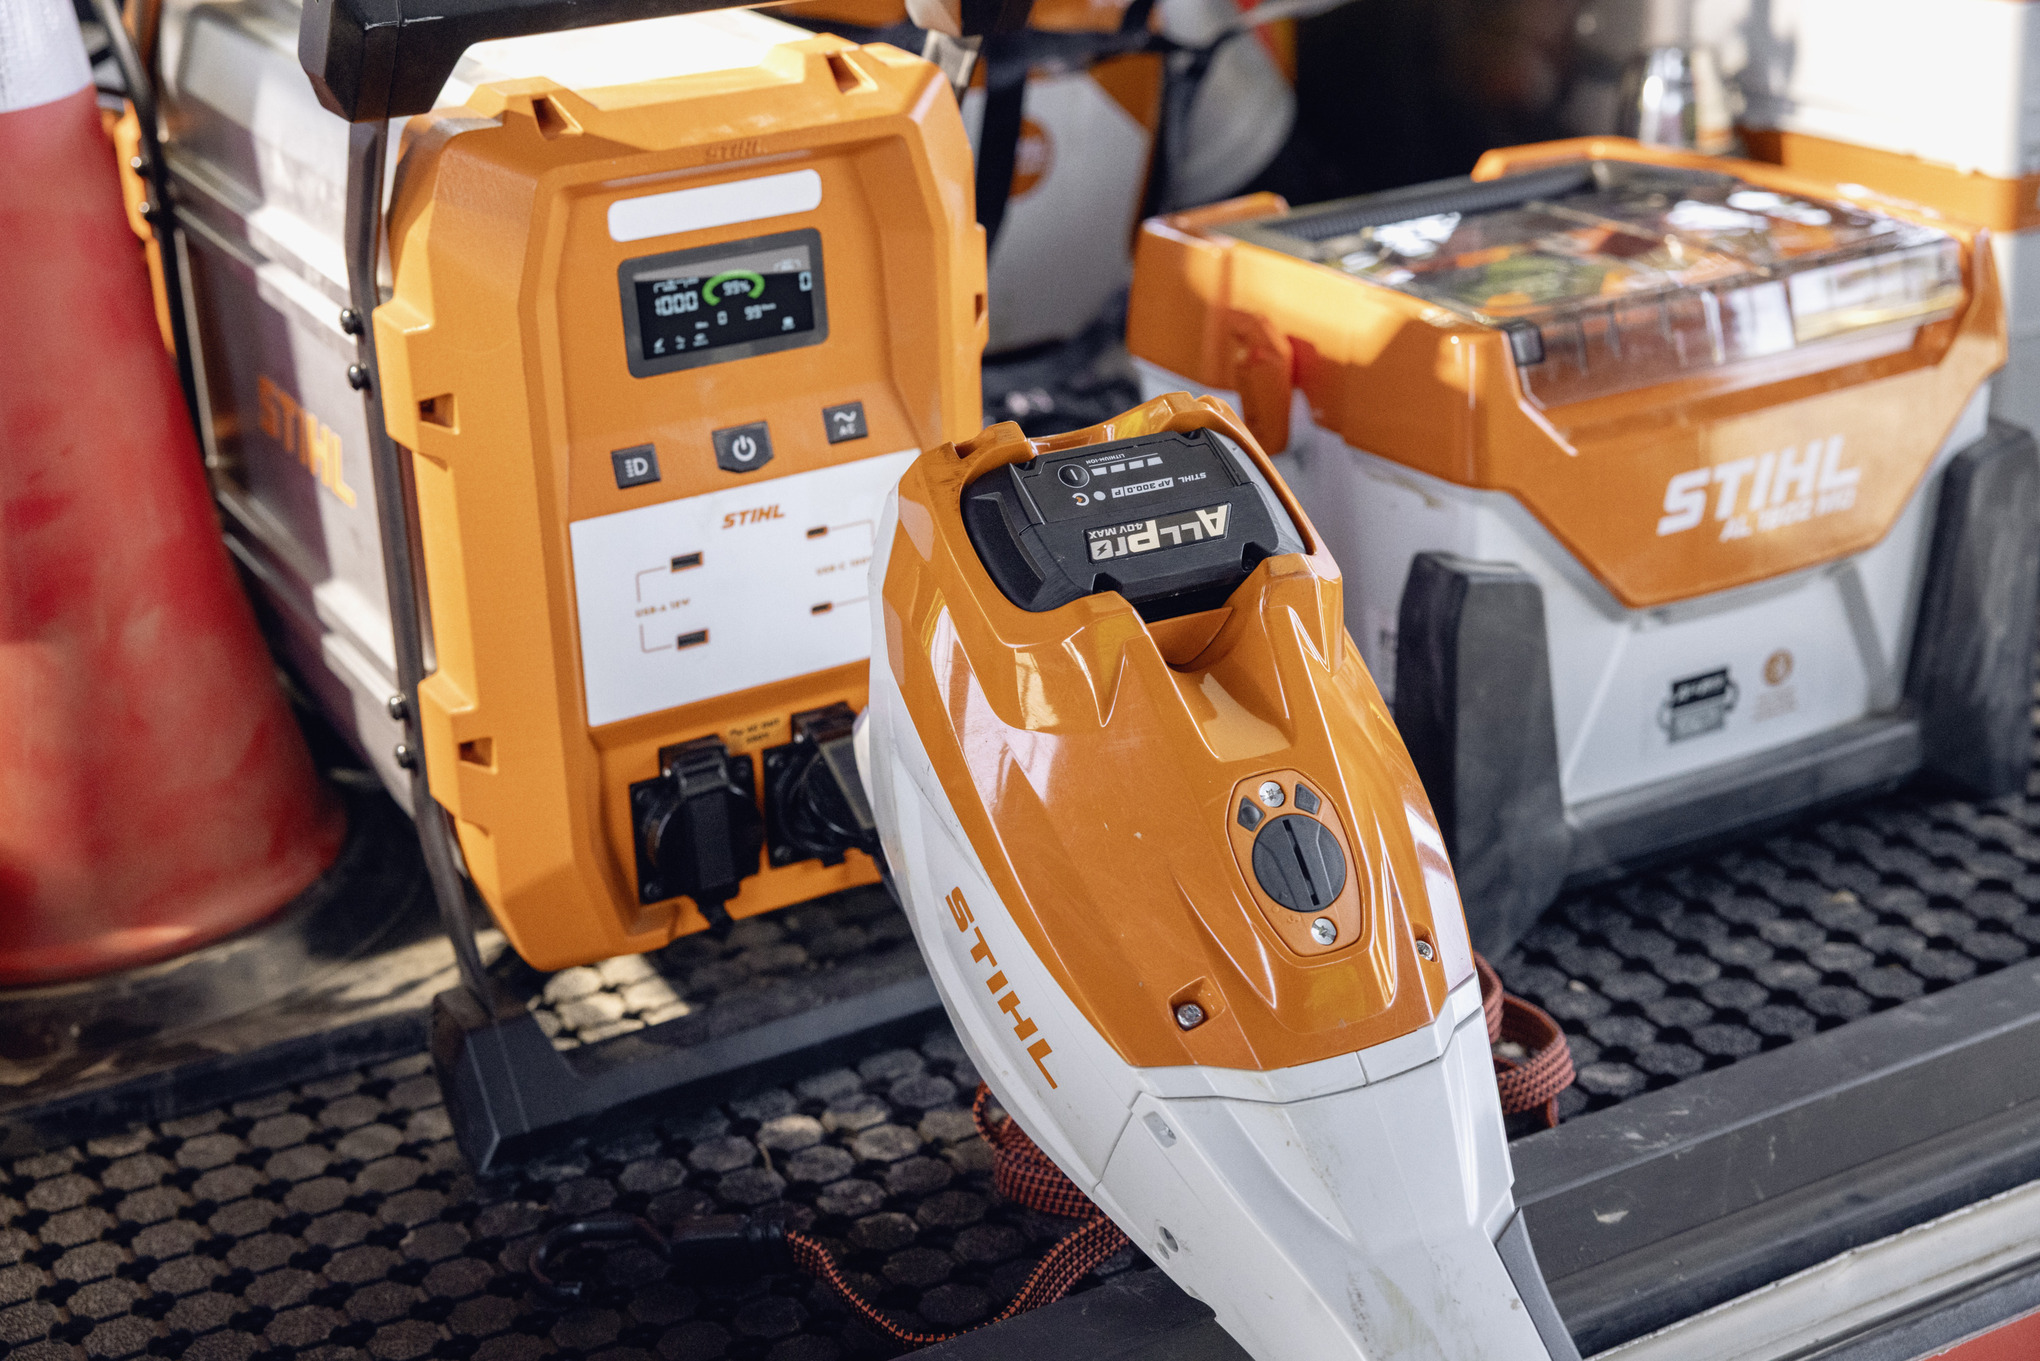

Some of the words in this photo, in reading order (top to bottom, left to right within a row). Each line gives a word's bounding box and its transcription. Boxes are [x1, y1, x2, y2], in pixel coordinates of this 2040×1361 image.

[257, 375, 358, 509] STIHL
[1177, 471, 1207, 484] STIHL
[1656, 433, 1862, 537] STIHL
[721, 503, 786, 529] STIHL
[1118, 521, 1144, 535] 40V
[1088, 526, 1118, 540] MAX
[944, 885, 1059, 1090] STIHL
